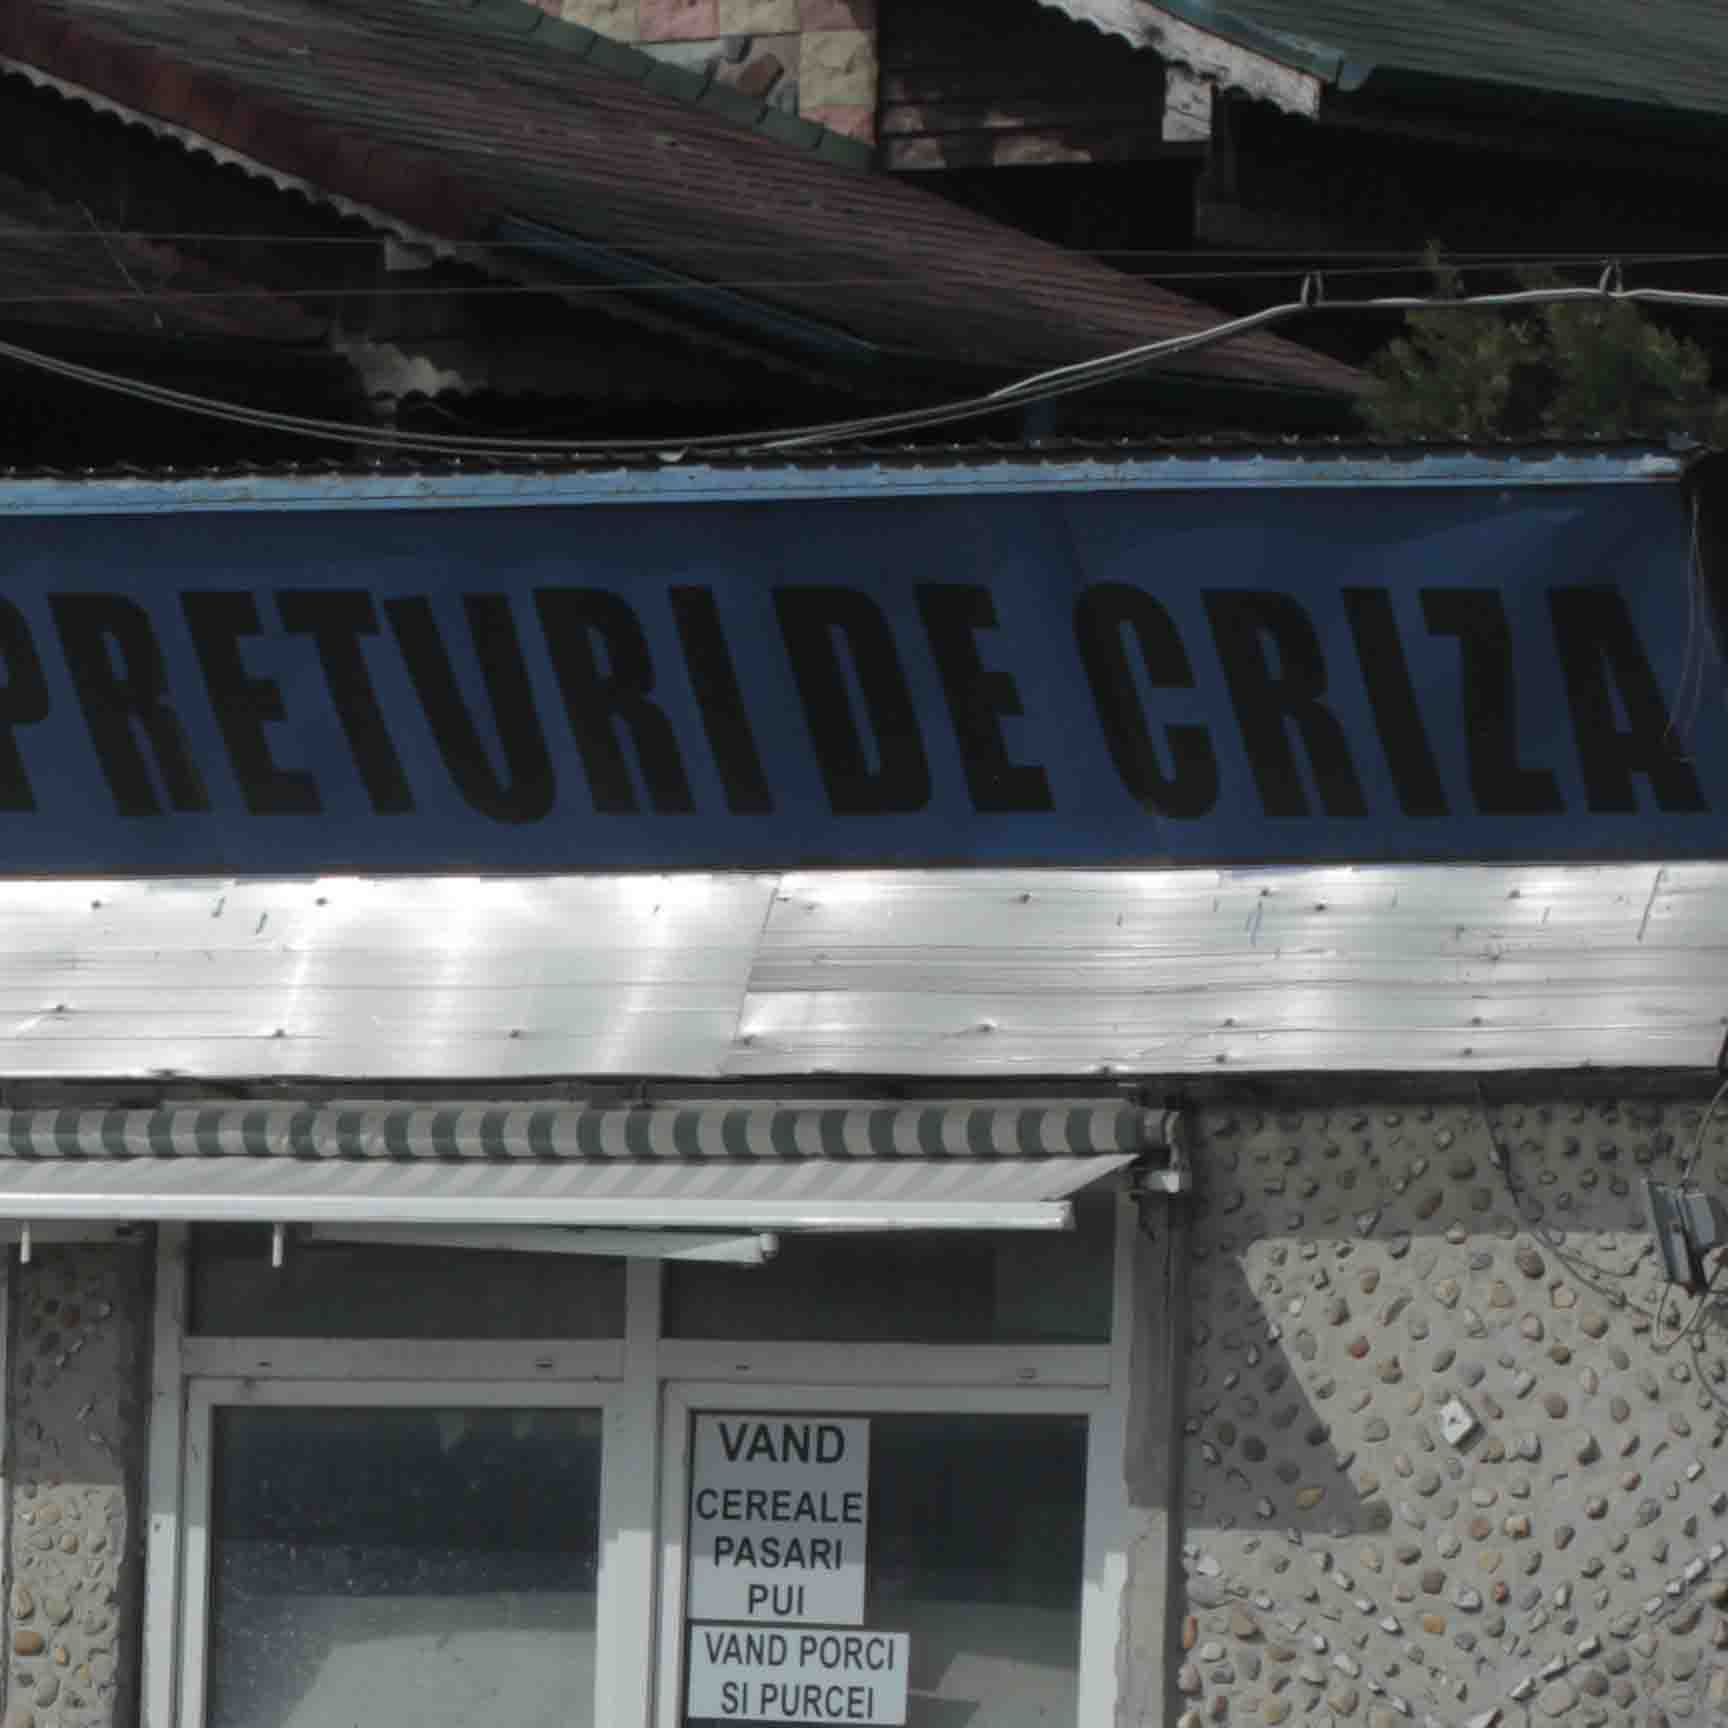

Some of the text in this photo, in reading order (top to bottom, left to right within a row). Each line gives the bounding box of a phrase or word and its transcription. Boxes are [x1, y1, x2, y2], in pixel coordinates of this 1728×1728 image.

[772, 584, 1056, 816] DE
[1073, 582, 1708, 820] CRIZA
[718, 1423, 845, 1463] VAND
[696, 1488, 863, 1524] CEREALE
[714, 1536, 843, 1569] PASARI
[749, 1584, 804, 1616] PUI
[705, 1632, 894, 1671] VAND PORCI
[722, 1682, 874, 1720] SI PURCEI
